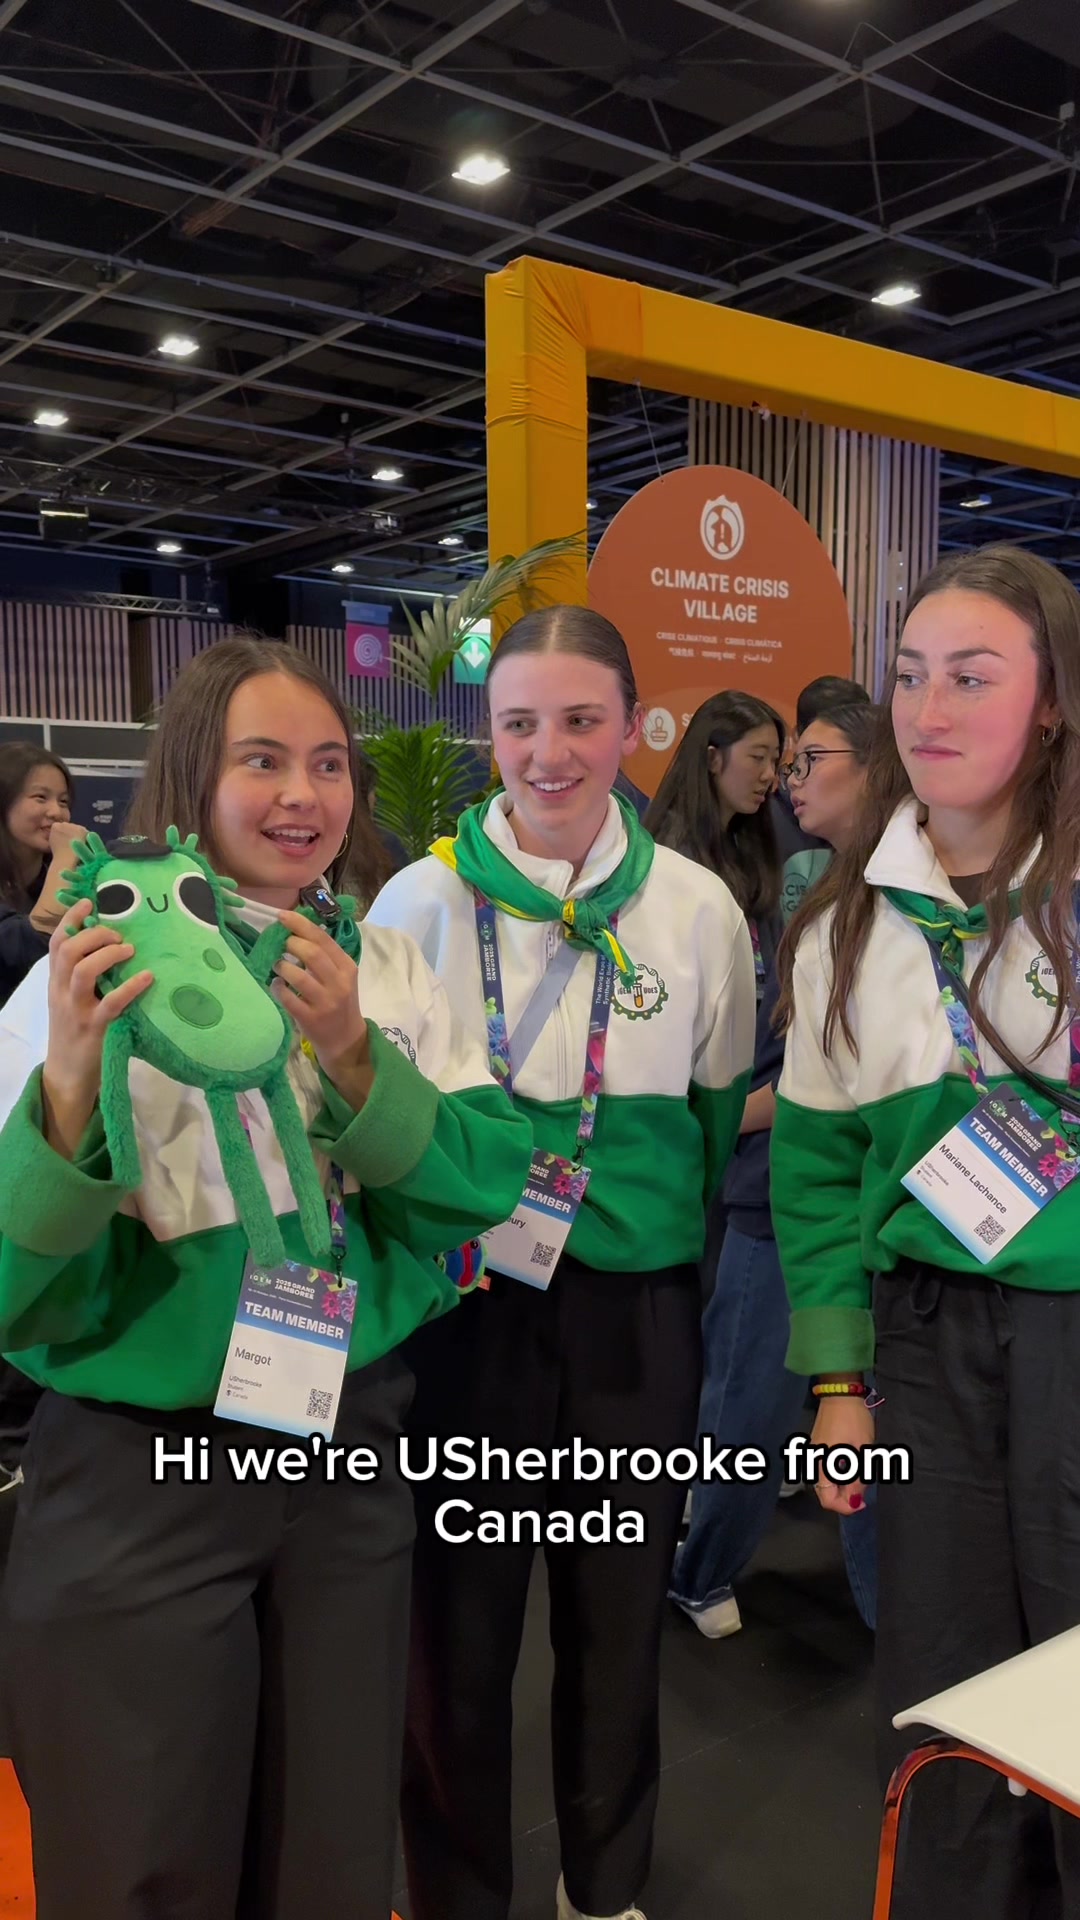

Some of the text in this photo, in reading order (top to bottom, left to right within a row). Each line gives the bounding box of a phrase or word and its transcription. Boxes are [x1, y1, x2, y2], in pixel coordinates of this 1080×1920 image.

[651, 567, 790, 598] CLIMATE CRISIS
[684, 599, 758, 623] VILLAGE
[1006, 1120, 1039, 1153] JAMBOREE
[969, 1116, 1003, 1152] TEAM
[998, 1146, 1049, 1198] MEMBER
[939, 1144, 1008, 1214] Mariane Lachance
[274, 1284, 315, 1300] JAMBOREE
[291, 1283, 316, 1294] GRAND
[244, 1301, 345, 1340] TEAM MEMBER
[234, 1346, 272, 1367] Margot
